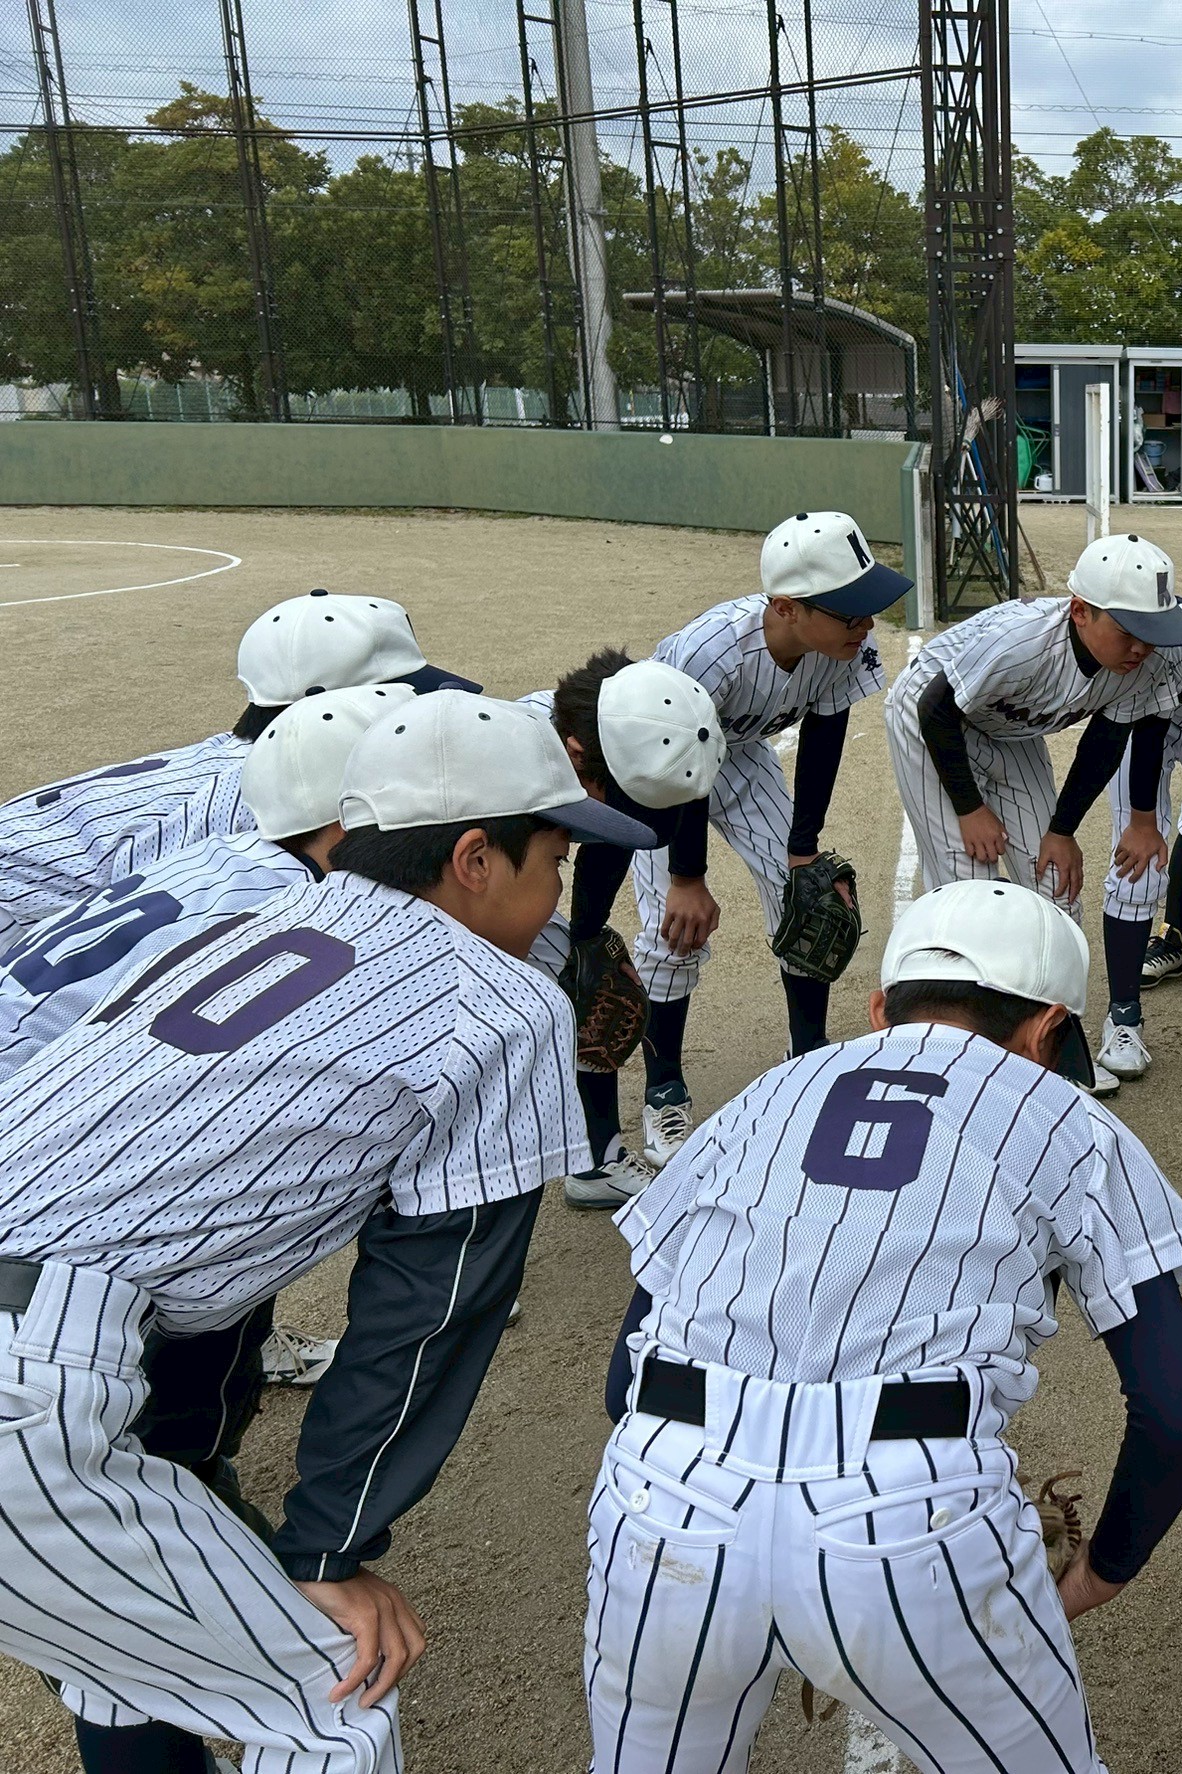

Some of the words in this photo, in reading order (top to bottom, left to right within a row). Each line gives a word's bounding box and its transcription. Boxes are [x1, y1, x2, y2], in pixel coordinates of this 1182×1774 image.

[846, 530, 871, 570] K
[1156, 572, 1171, 607] K
[86, 912, 356, 1056] 10
[801, 1068, 949, 1192] 6
